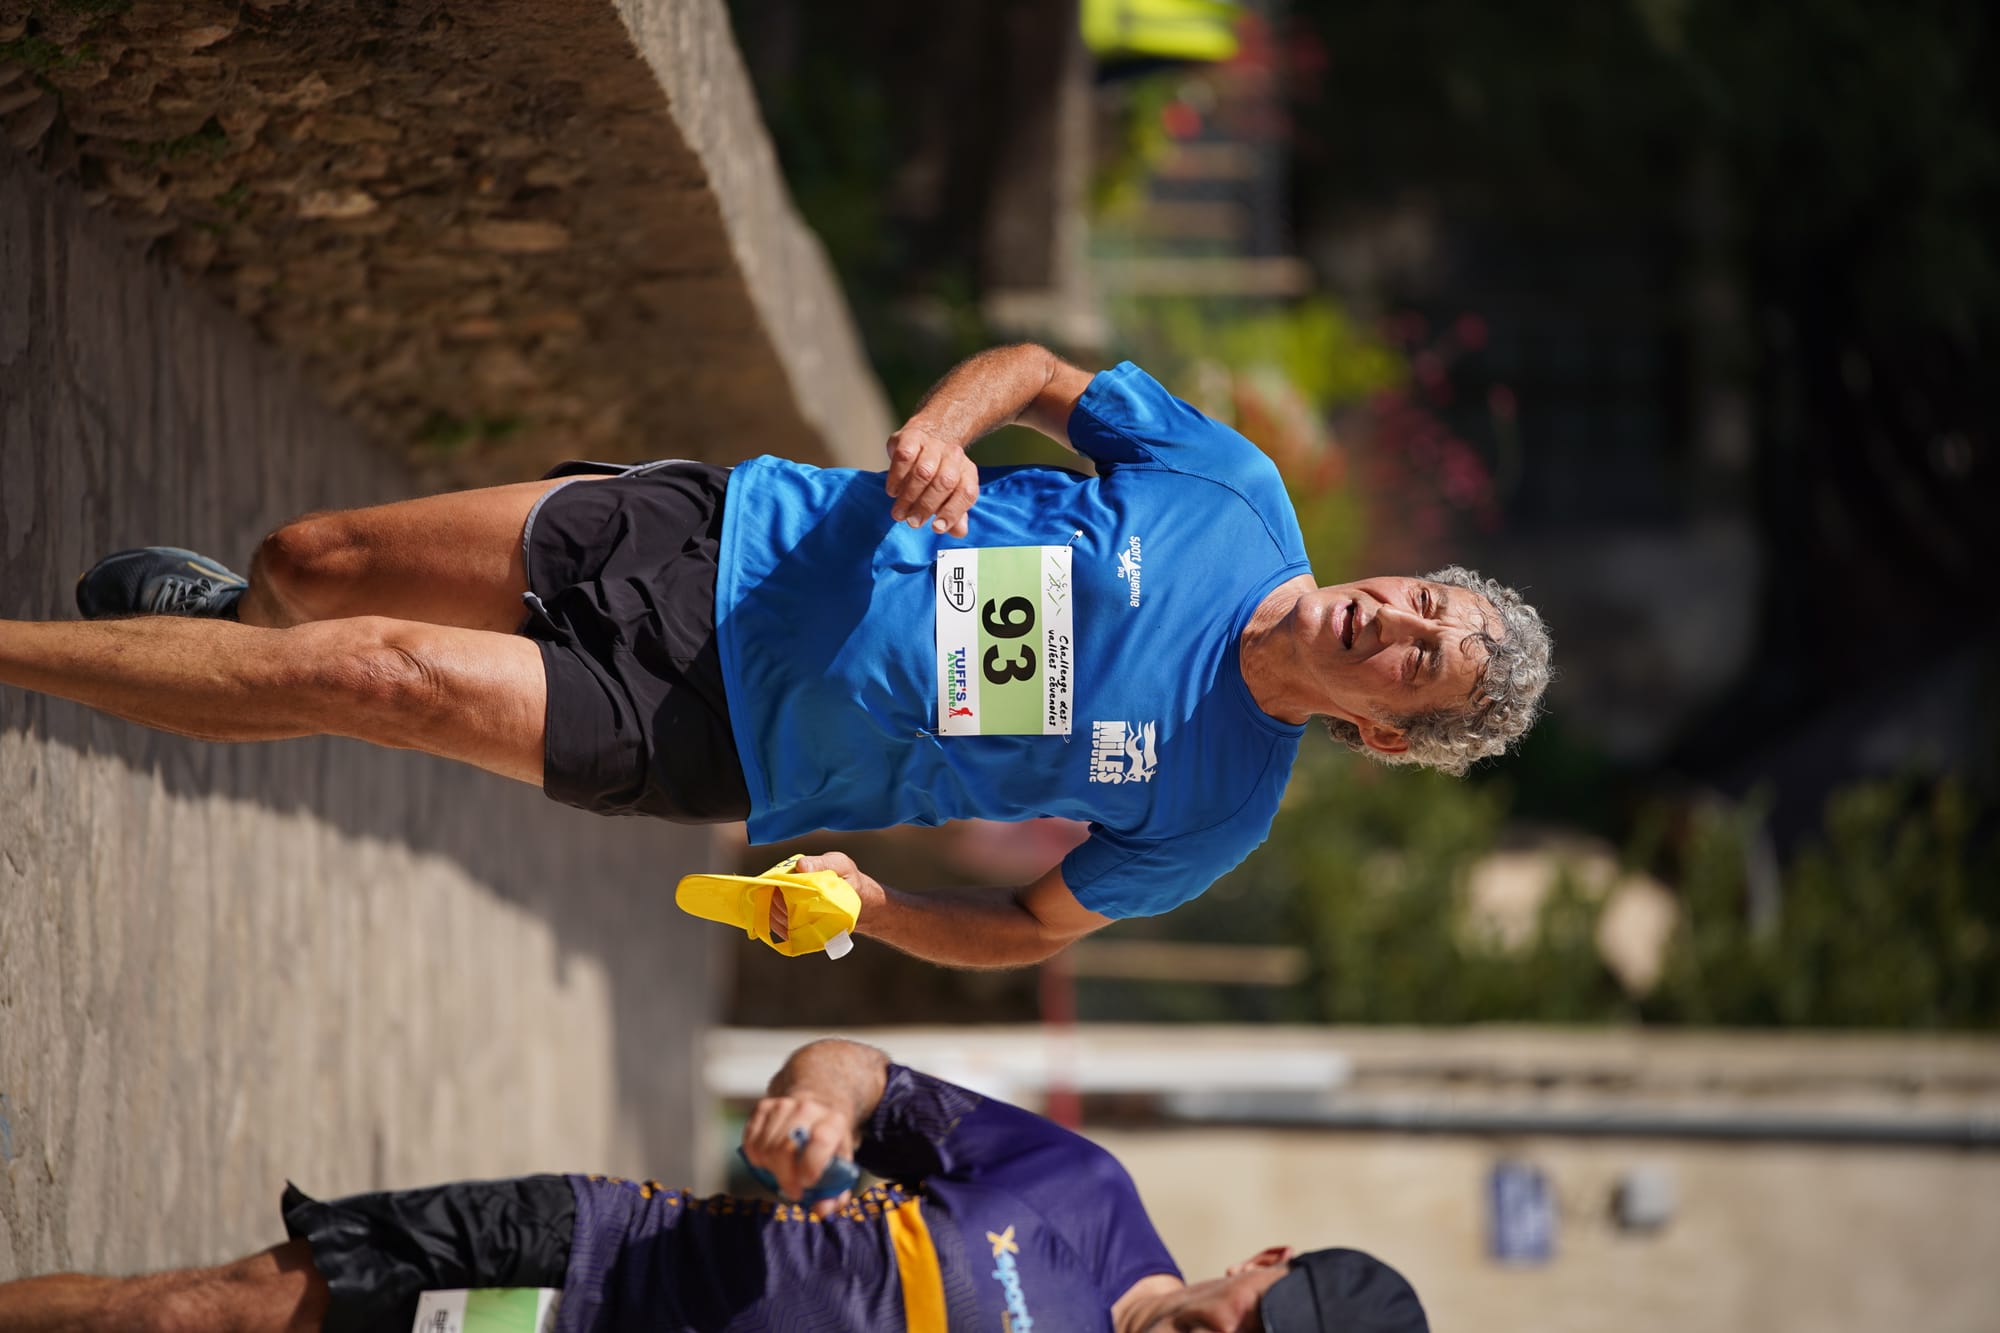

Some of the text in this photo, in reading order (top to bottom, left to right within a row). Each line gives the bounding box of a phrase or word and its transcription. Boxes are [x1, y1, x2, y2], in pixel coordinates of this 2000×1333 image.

[1129, 535, 1142, 562] sport
[953, 567, 964, 606] BFP
[981, 596, 1036, 685] 93
[947, 652, 957, 708] Aventure
[954, 647, 967, 702] TUFF'S
[1048, 629, 1058, 727] vallées cévenoles
[1058, 635, 1069, 720] Challenge des
[1089, 721, 1101, 783] REPUBLIC
